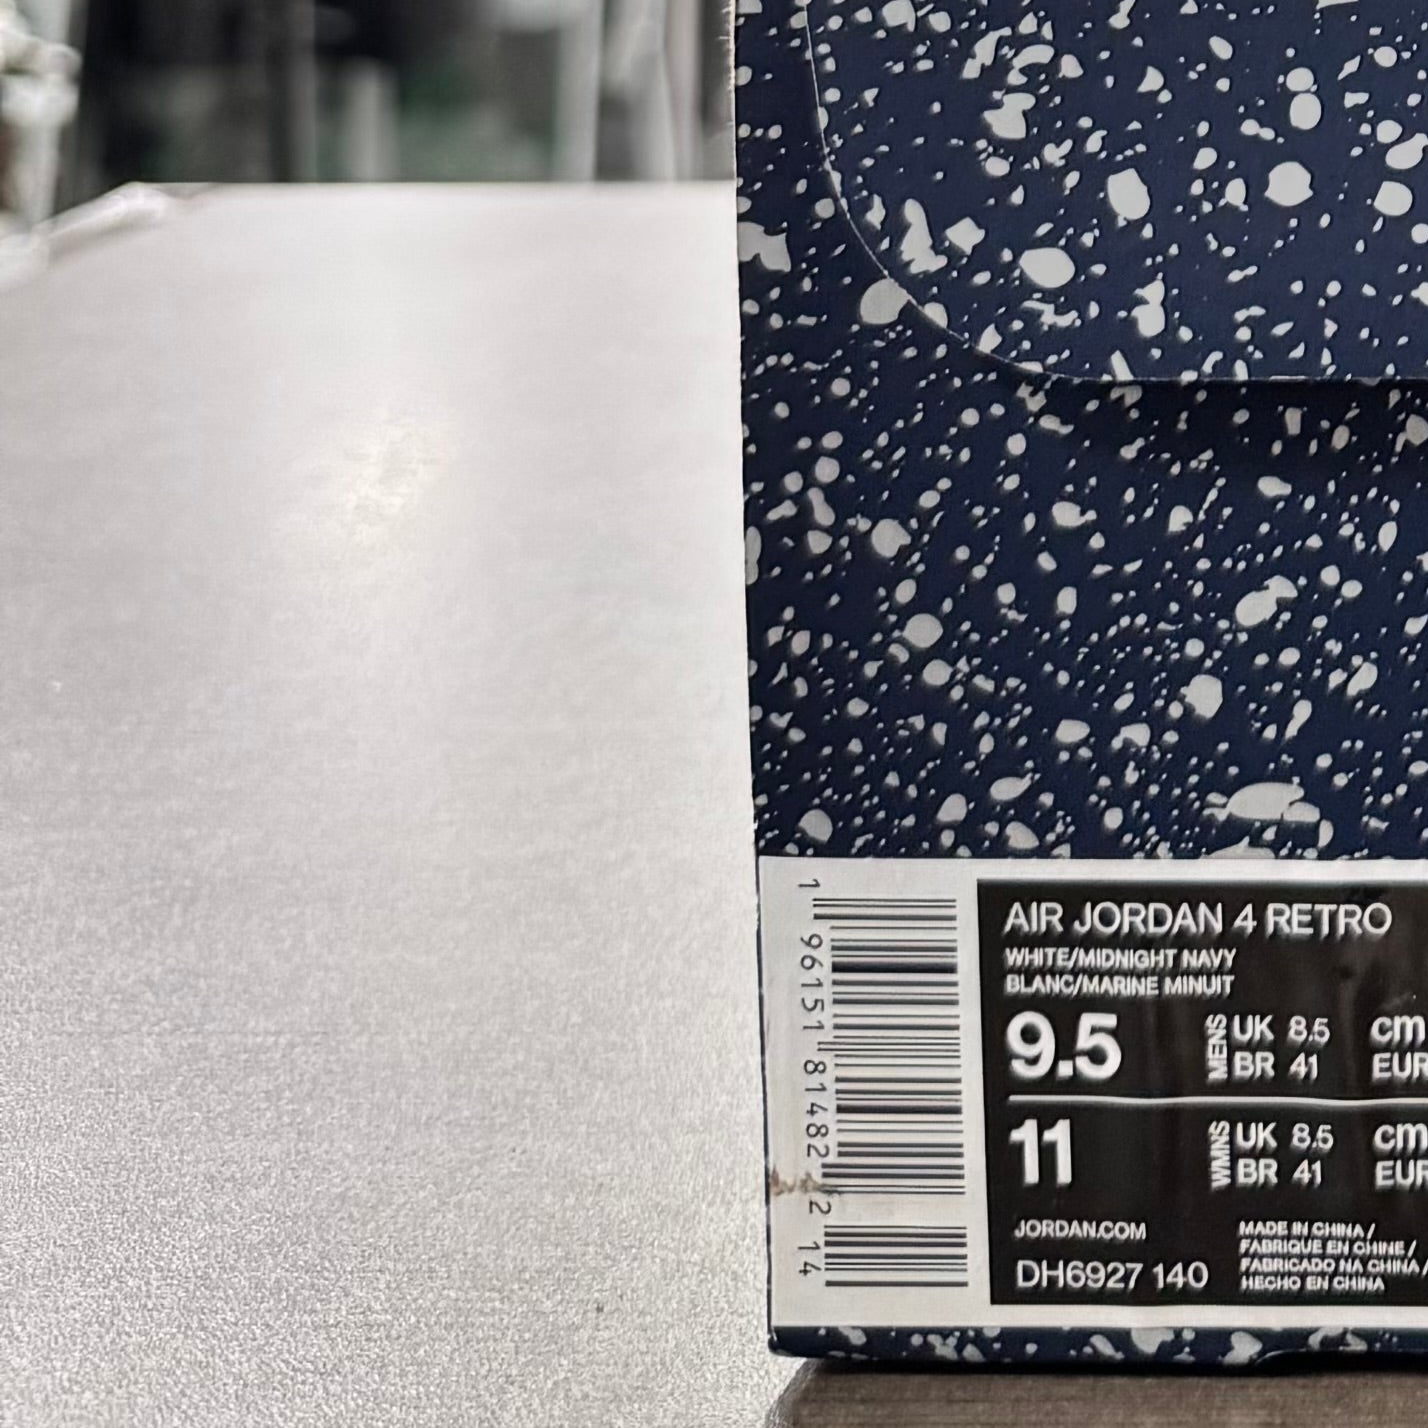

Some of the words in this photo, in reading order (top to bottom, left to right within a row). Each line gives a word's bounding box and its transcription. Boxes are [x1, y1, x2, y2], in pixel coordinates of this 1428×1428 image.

[1003, 902, 1064, 934] AIR
[1073, 901, 1224, 935] JORDAN
[1233, 903, 1258, 934] 4
[1266, 902, 1393, 935] RETRO
[1005, 947, 1178, 971] WHITE/MIDNIGHT
[1182, 947, 1237, 970] NAVY
[799, 932, 826, 1032] 96151
[1006, 973, 1160, 998] BLANC/MARINE
[1164, 974, 1235, 996] MINUIT
[1233, 1015, 1275, 1043] UK
[1288, 1016, 1331, 1044] 8.5
[1370, 1015, 1426, 1045] cm
[1006, 1010, 1122, 1081] 9.5
[1206, 1013, 1228, 1082] MENS
[1233, 1050, 1275, 1079] BR
[1289, 1052, 1319, 1079] 41
[803, 1059, 831, 1159] 81482
[1236, 1122, 1278, 1150] UK
[1291, 1123, 1334, 1151] 8.5
[1374, 1123, 1428, 1151] cm
[1008, 1118, 1072, 1186] 11
[1209, 1120, 1231, 1190] WMNS
[1237, 1158, 1278, 1186] BR
[1292, 1159, 1322, 1186] 41
[1014, 1220, 1147, 1241] JORDAN.COM
[1239, 1220, 1289, 1237] MADE
[1292, 1221, 1309, 1237] IN
[1239, 1238, 1323, 1255] FABRIQUE
[1326, 1240, 1350, 1255] EN
[1016, 1260, 1143, 1291] DH6927
[1152, 1260, 1210, 1290] 140
[1240, 1257, 1336, 1273] FABRICADO
[1241, 1275, 1302, 1291] HECHO
[1306, 1275, 1330, 1291] EN
[1333, 1275, 1386, 1291] CHINA
